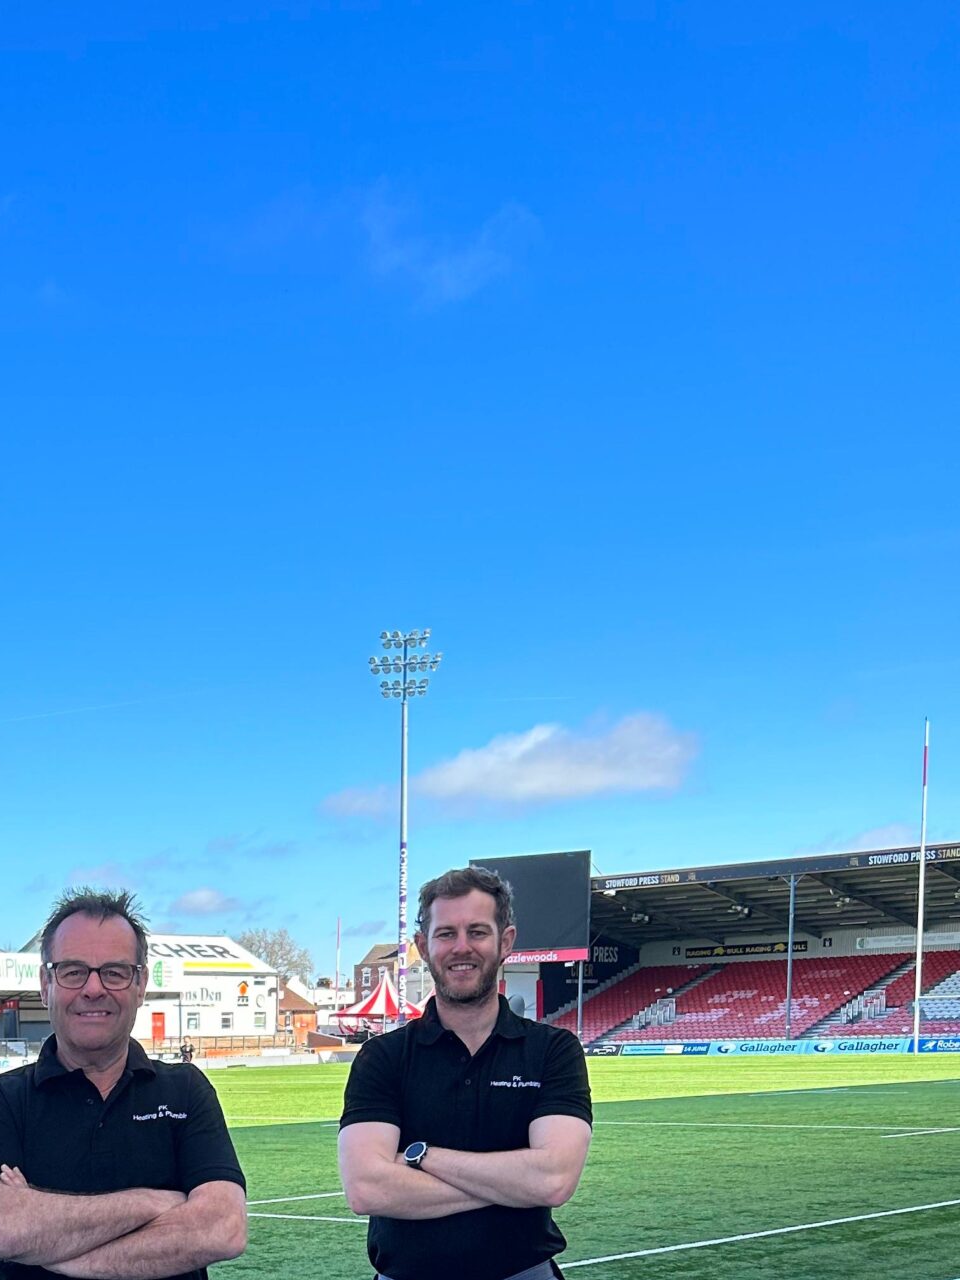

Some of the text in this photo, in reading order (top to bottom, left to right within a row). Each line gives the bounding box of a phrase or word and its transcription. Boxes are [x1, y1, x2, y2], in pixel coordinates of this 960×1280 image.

[868, 853, 909, 865] STOWFORD
[910, 850, 936, 861] PRSS
[605, 873, 680, 889] STOWFORD PRESS STAND
[148, 942, 240, 959] CHER
[593, 946, 619, 963] PRESS
[200, 987, 222, 1002] Den
[740, 1042, 797, 1054] Gallagher
[837, 1041, 899, 1053] Gallagher
[132, 1113, 157, 1121] Heating
